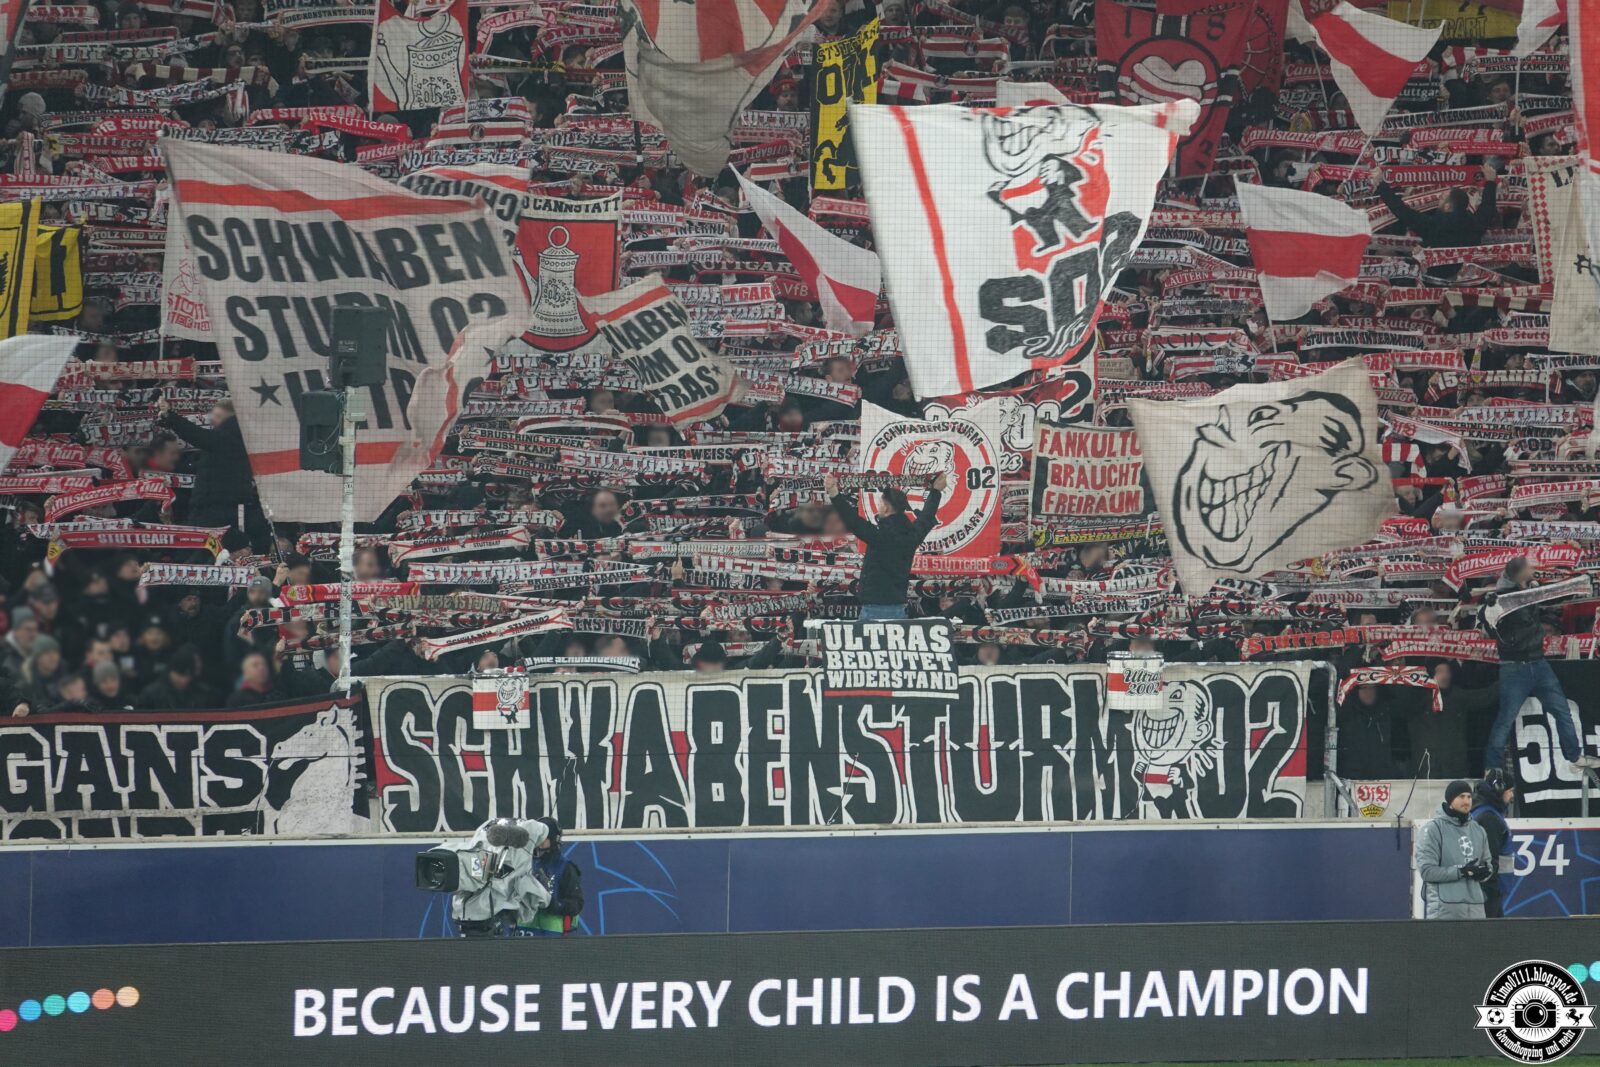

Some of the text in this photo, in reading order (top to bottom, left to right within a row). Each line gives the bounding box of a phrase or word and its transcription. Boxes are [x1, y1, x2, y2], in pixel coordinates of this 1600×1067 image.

[1383, 168, 1467, 184] Commando
[533, 196, 621, 215] CANNSTATT
[91, 231, 144, 241] STOLZ UND
[187, 214, 507, 290] SCHWABEN
[698, 261, 799, 274] UTTGAR
[783, 281, 809, 297] VfB
[225, 292, 429, 364] STUM
[1361, 331, 1425, 350] INTERNATION
[480, 428, 585, 449] BRUSTRING TRAGEN
[875, 421, 985, 450] SCHWABENSTURM
[1038, 428, 1143, 458] FANKULTU
[485, 440, 523, 453] HEISST
[691, 448, 733, 461] WEISS
[966, 465, 997, 490] 02
[1049, 461, 1143, 491] BRAUCHT
[1514, 481, 1593, 498] NNSTATTER
[1044, 490, 1141, 514] FREIRAUM
[97, 533, 176, 545] STUTTGART
[918, 507, 985, 552] STUTTGART
[823, 622, 951, 653] ULTRAS
[826, 651, 954, 671] BEDEUTET
[827, 670, 959, 690] WIDERSTAND
[1512, 834, 1570, 877] 34
[293, 967, 1369, 1037] BECAUSE EVERY CHILD IS A CHAMPION
